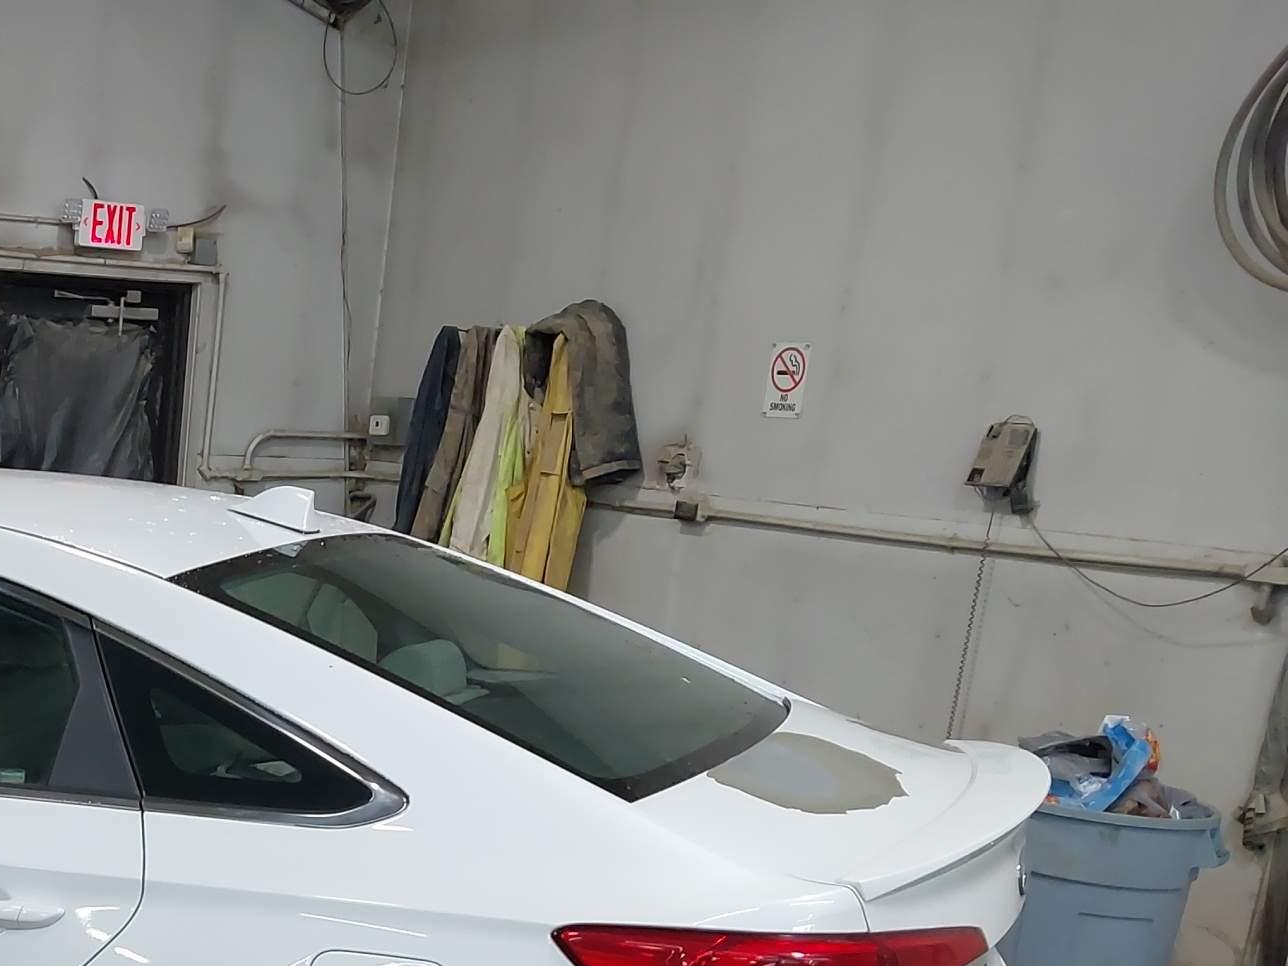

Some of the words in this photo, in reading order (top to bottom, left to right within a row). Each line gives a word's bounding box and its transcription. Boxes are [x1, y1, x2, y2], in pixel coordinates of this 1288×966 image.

[91, 203, 137, 246] EXIT
[779, 394, 789, 402] NO
[769, 402, 797, 412] SMOKING
